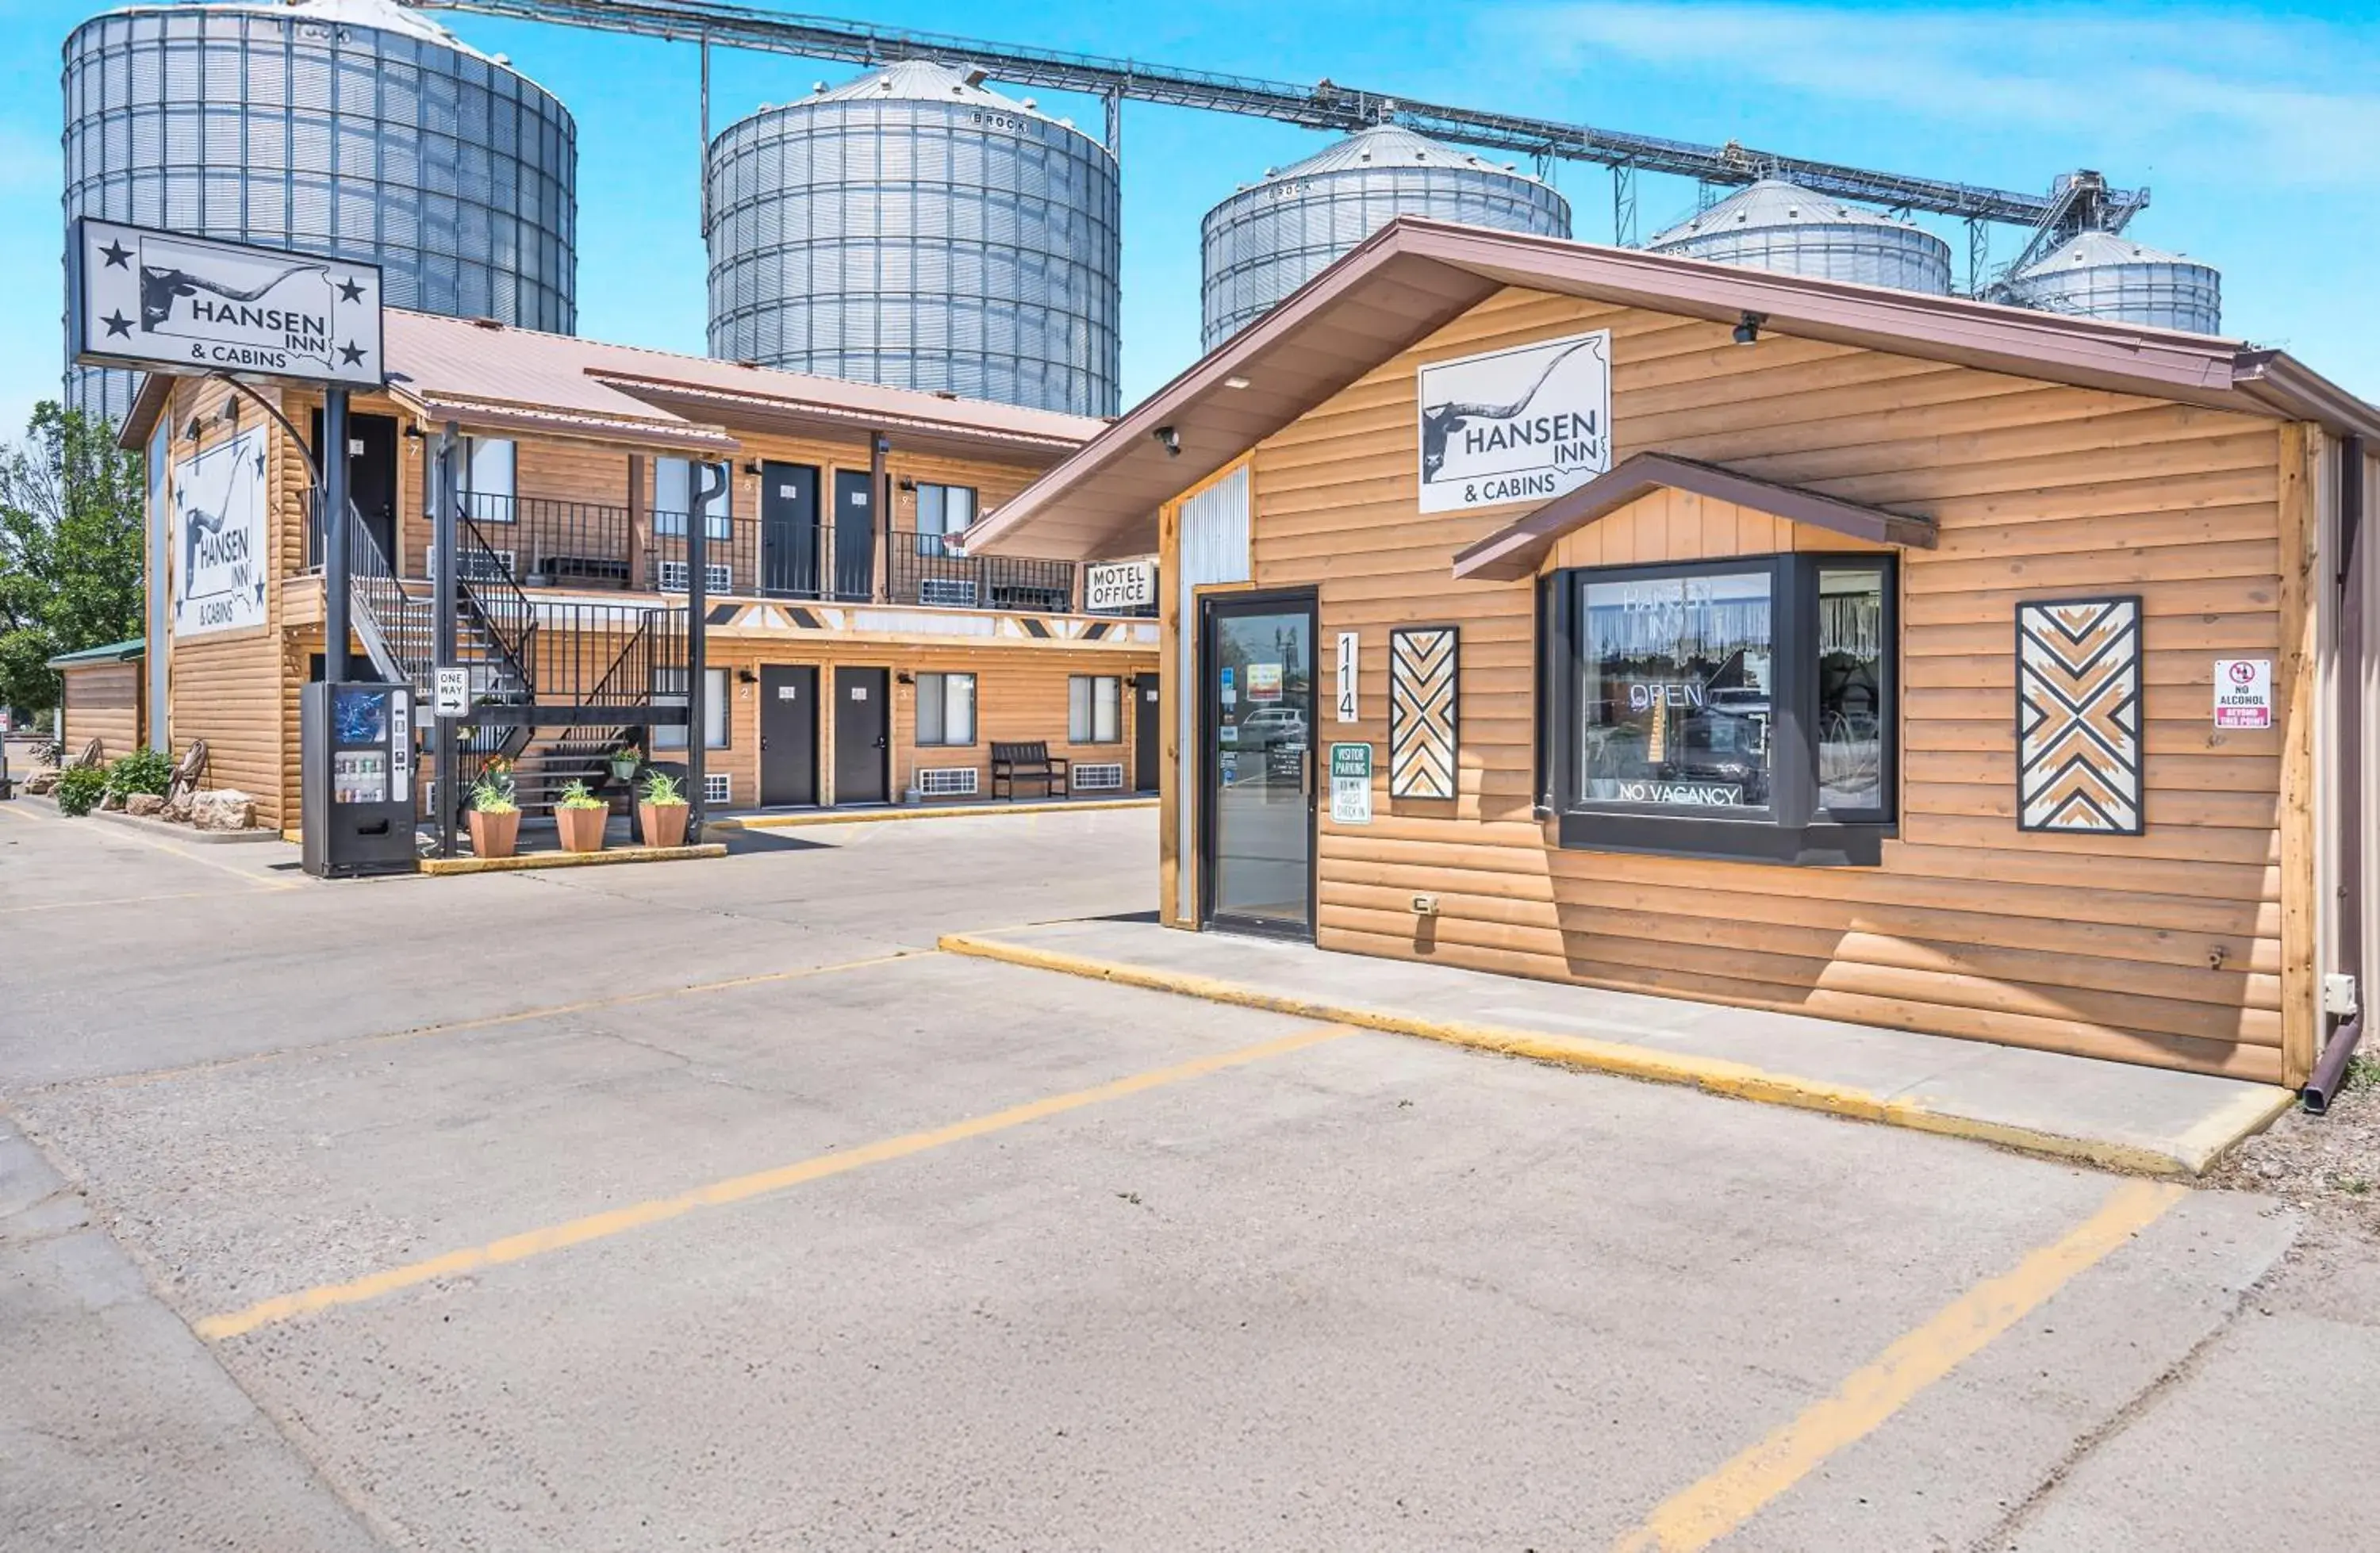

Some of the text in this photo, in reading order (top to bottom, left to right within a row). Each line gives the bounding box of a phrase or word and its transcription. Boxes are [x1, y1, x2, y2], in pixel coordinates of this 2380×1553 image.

[974, 113, 1025, 133] BROCK
[193, 299, 324, 336] HANSEN
[286, 334, 325, 353] INN
[191, 343, 286, 368] & CABINS
[1466, 410, 1595, 454] HANSEN
[1555, 440, 1597, 464] INN
[1464, 474, 1556, 502] & CABINS
[200, 527, 248, 569] HANSEN
[231, 563, 248, 589] INN
[1094, 566, 1145, 586] MOTEL
[1094, 584, 1144, 604] OFFICE
[199, 600, 232, 626] & CABINS
[440, 673, 462, 683] ONE
[440, 685, 462, 695] WAY
[1630, 684, 1702, 707] OPEN
[2235, 685, 2249, 694] NO
[2221, 696, 2264, 705] ALCOHOL
[1337, 748, 1365, 761] VISITOR
[1335, 761, 1365, 775] PARKING
[1619, 783, 1739, 805] NO VACANCY
